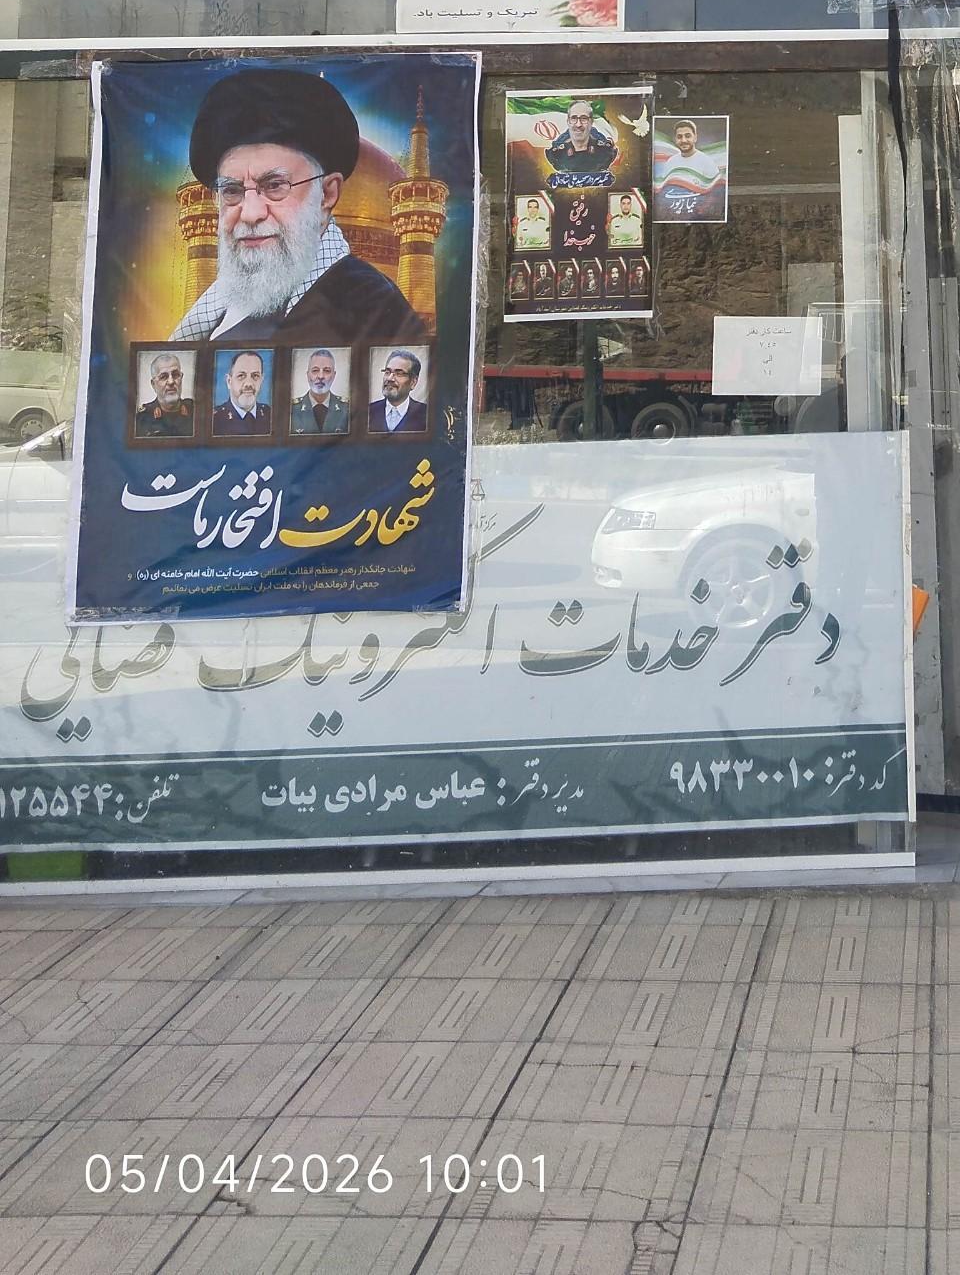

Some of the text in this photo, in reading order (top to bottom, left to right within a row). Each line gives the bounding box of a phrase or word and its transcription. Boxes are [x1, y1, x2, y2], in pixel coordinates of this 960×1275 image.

[437, 8, 483, 18] تسلیت
[487, 10, 493, 18] و
[496, 7, 539, 19] تبریک
[121, 457, 436, 549] شهادت افتخار ماست
[150, 569, 160, 581] ای
[161, 570, 184, 580] خامنه
[184, 569, 200, 581] امام
[201, 566, 215, 577] الله
[215, 567, 232, 579] آیت
[232, 569, 259, 582] حضرت
[387, 564, 416, 575] شهادت
[719, 537, 841, 687] دفتر
[518, 576, 720, 676] خدمات
[19, 622, 177, 742] ضایی
[870, 745, 907, 792] کد
[114, 773, 180, 824] تلفن:
[261, 777, 316, 814] بیات
[324, 773, 408, 814] مرادی
[415, 770, 486, 811] عباس
[553, 773, 585, 815] مدیر
